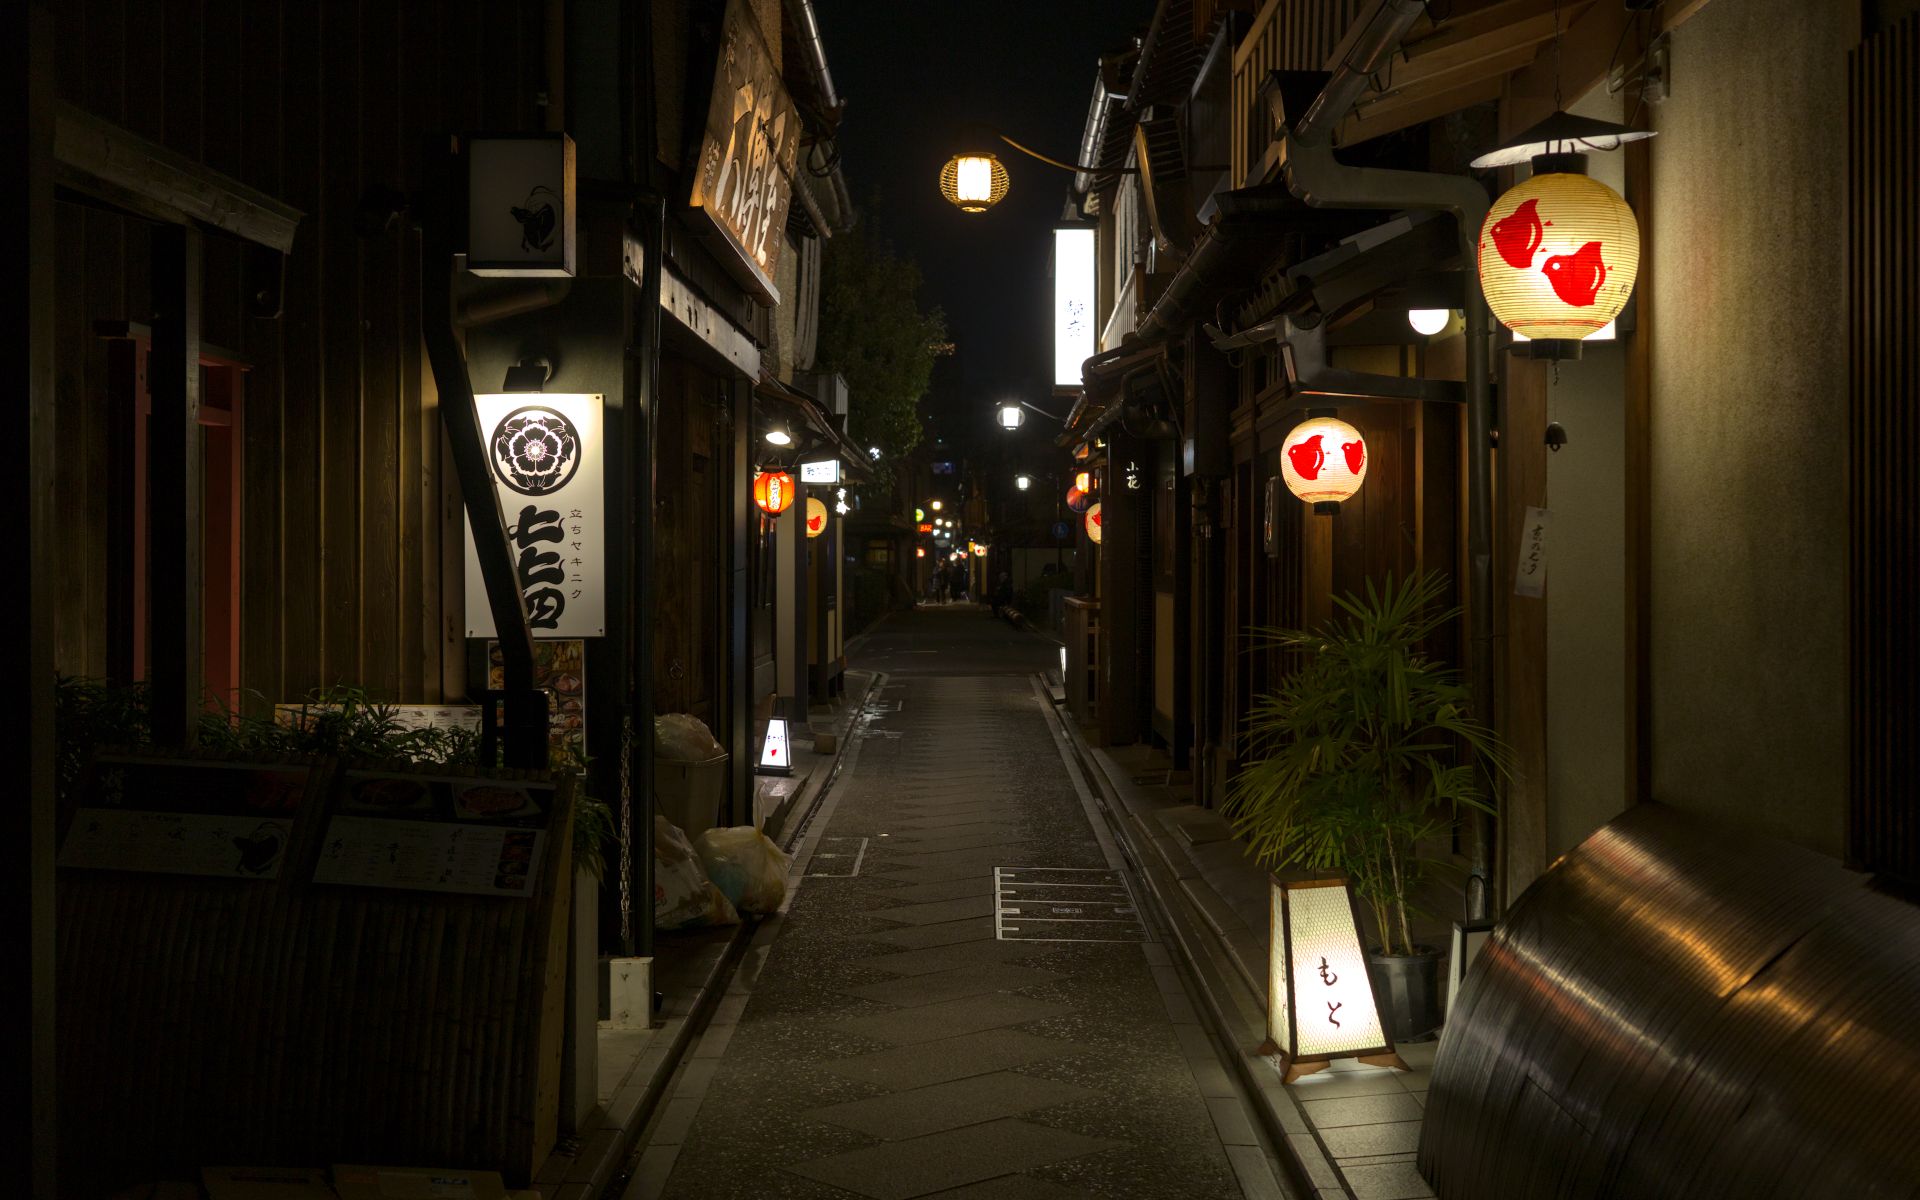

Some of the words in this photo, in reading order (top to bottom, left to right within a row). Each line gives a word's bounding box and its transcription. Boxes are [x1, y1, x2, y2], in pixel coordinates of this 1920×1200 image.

[569, 508, 584, 600] 立ちヤキニク
[1316, 956, 1343, 1030] もと
